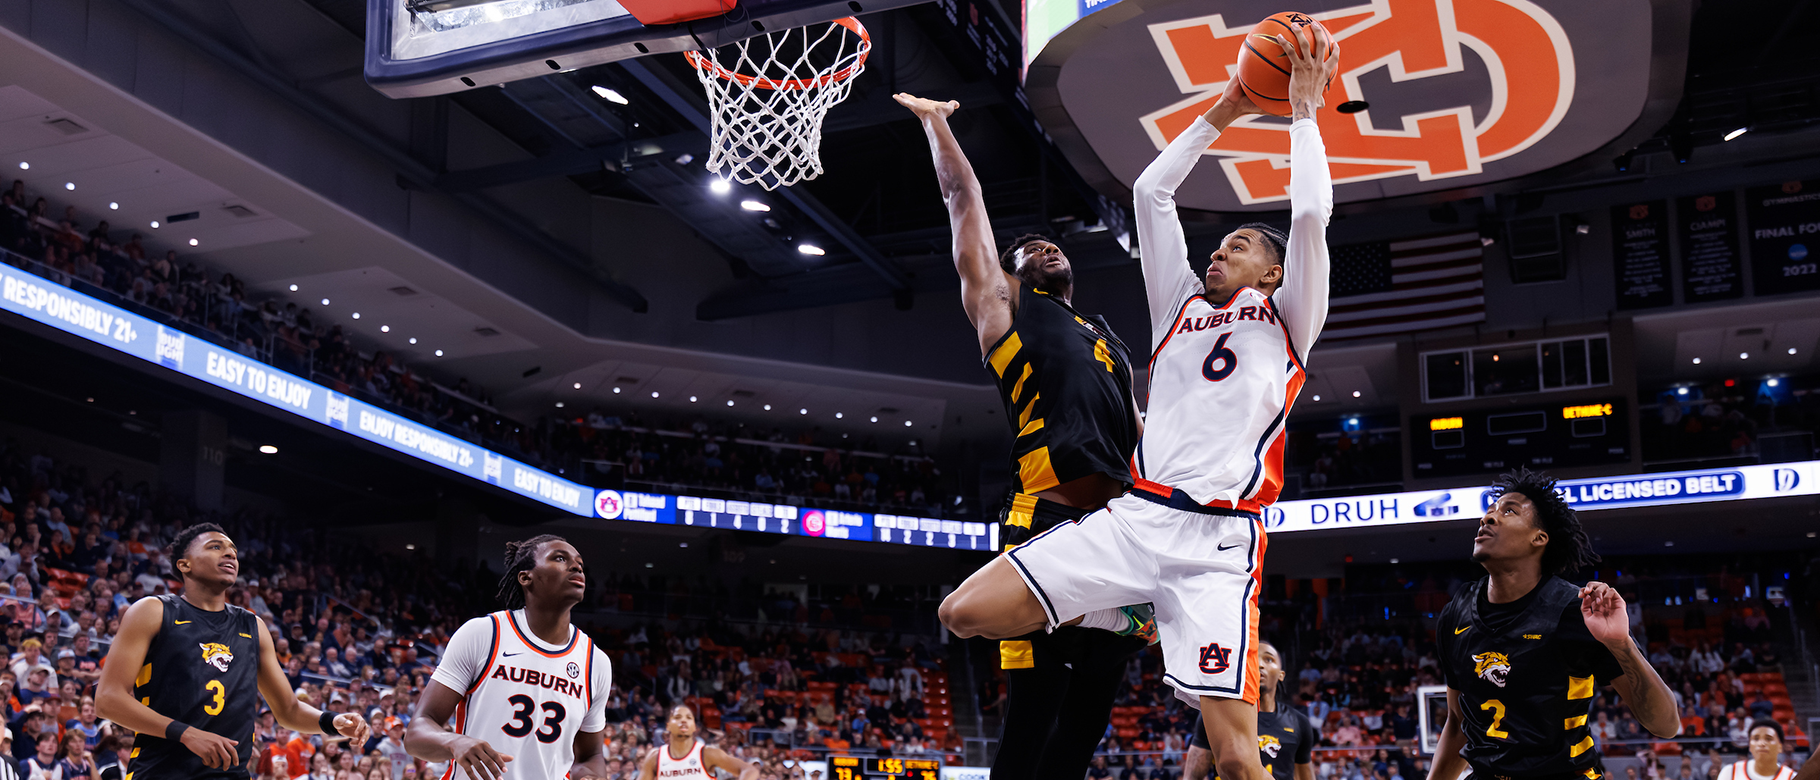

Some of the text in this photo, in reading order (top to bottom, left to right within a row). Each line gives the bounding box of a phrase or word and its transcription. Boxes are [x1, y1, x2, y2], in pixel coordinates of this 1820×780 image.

[1625, 228, 1656, 240] SMITH
[1754, 225, 1795, 240] FINAL
[1782, 262, 1817, 277] 2022
[3, 275, 137, 344] RESPONSIBLY 21+
[1177, 305, 1276, 335] AUBURN
[159, 332, 183, 351] BUD
[1202, 331, 1238, 382] 6
[206, 351, 312, 410] EASY TO ENJOY
[359, 409, 395, 440] ENJOY
[394, 422, 460, 464] RESPONSIBLY
[458, 447, 474, 468] 21+
[203, 445, 224, 466] 110
[514, 467, 540, 494] EASY
[539, 477, 552, 499] TO
[551, 481, 581, 508] ENJOY
[1579, 478, 1682, 502] LICENSED
[1685, 473, 1737, 495] BELT
[1311, 498, 1398, 525] DRUH
[204, 680, 226, 716] 3
[491, 664, 583, 700] AUBURN
[501, 694, 566, 744] 33
[1480, 699, 1509, 739] 2
[660, 768, 702, 778] AUBURN
